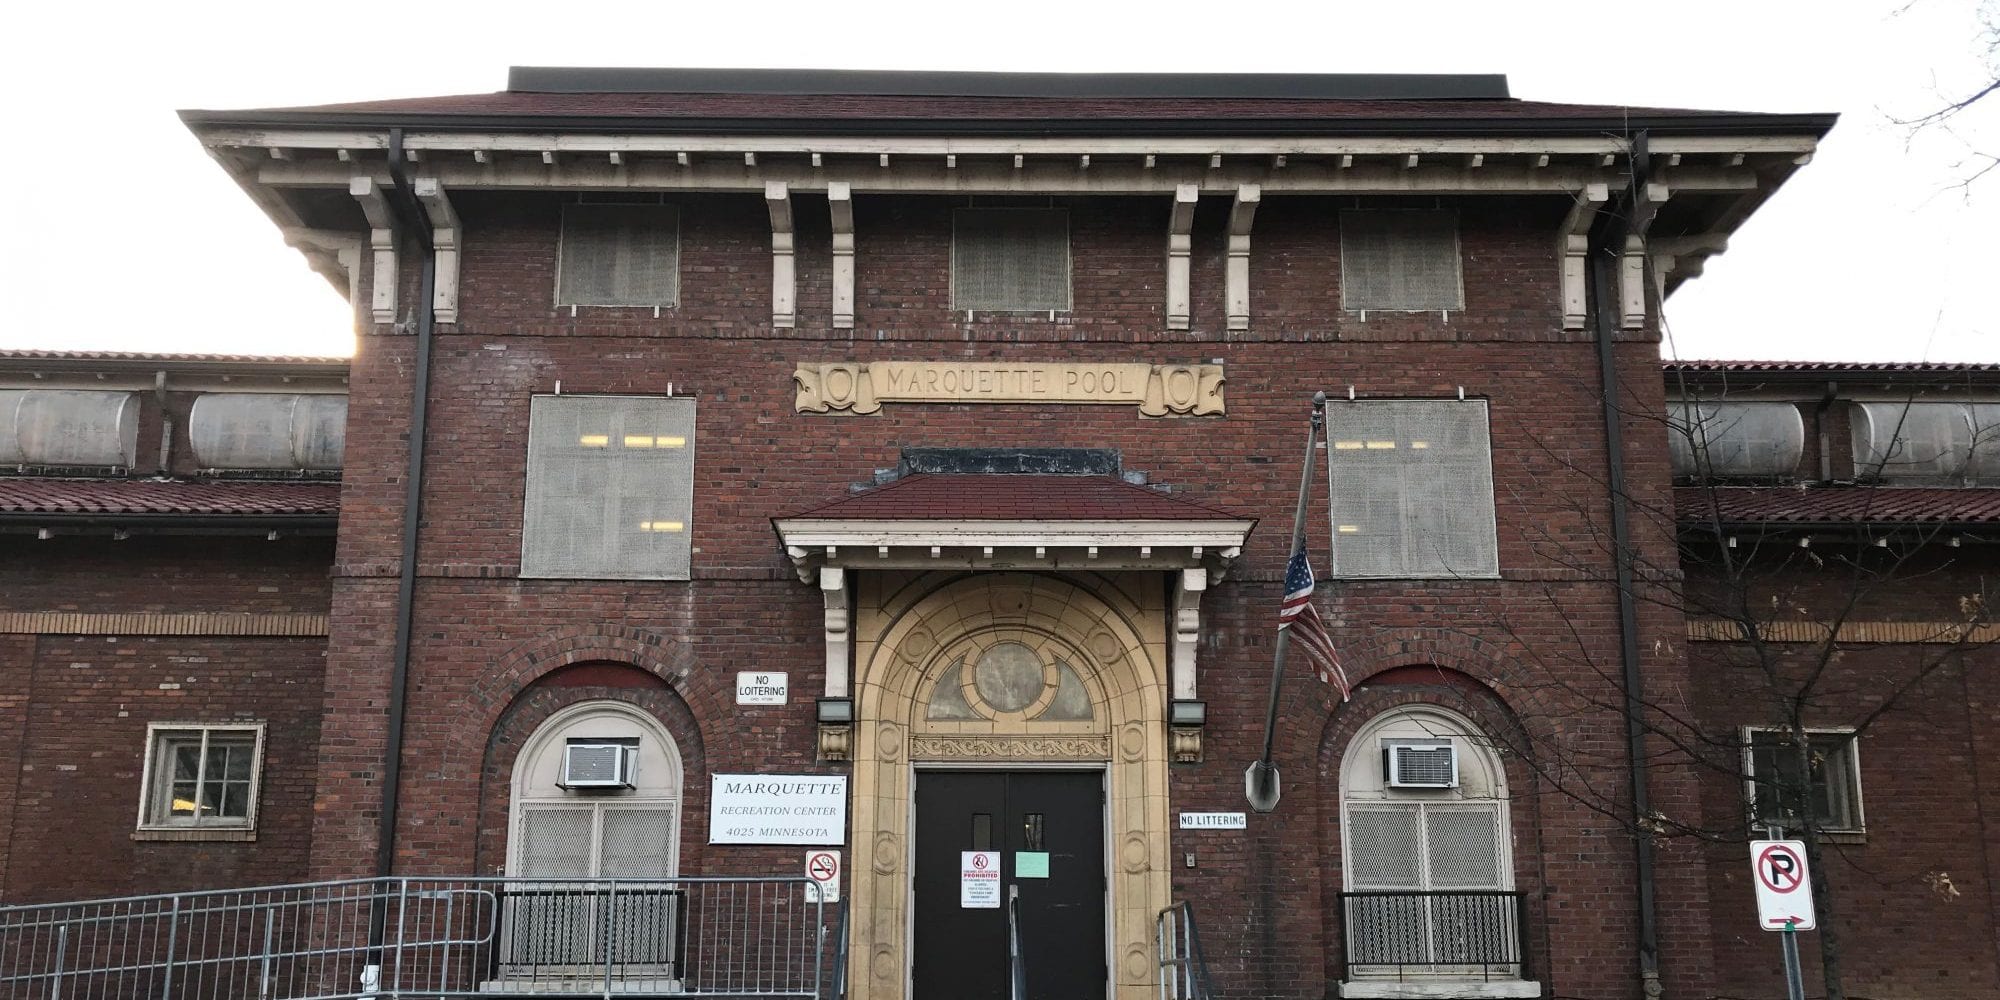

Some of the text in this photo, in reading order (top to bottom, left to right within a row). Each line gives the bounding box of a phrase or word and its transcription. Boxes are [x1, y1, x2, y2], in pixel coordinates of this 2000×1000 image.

[887, 369, 1132, 394] MARQUETTE POOL
[756, 675, 769, 685] NO
[740, 686, 785, 696] LOITERING
[724, 783, 842, 796] MARQUETTE
[720, 806, 836, 816] RECREATION CENTER
[1181, 815, 1244, 825] NO LITTERING
[726, 827, 829, 837] 4025 MINNESOTA
